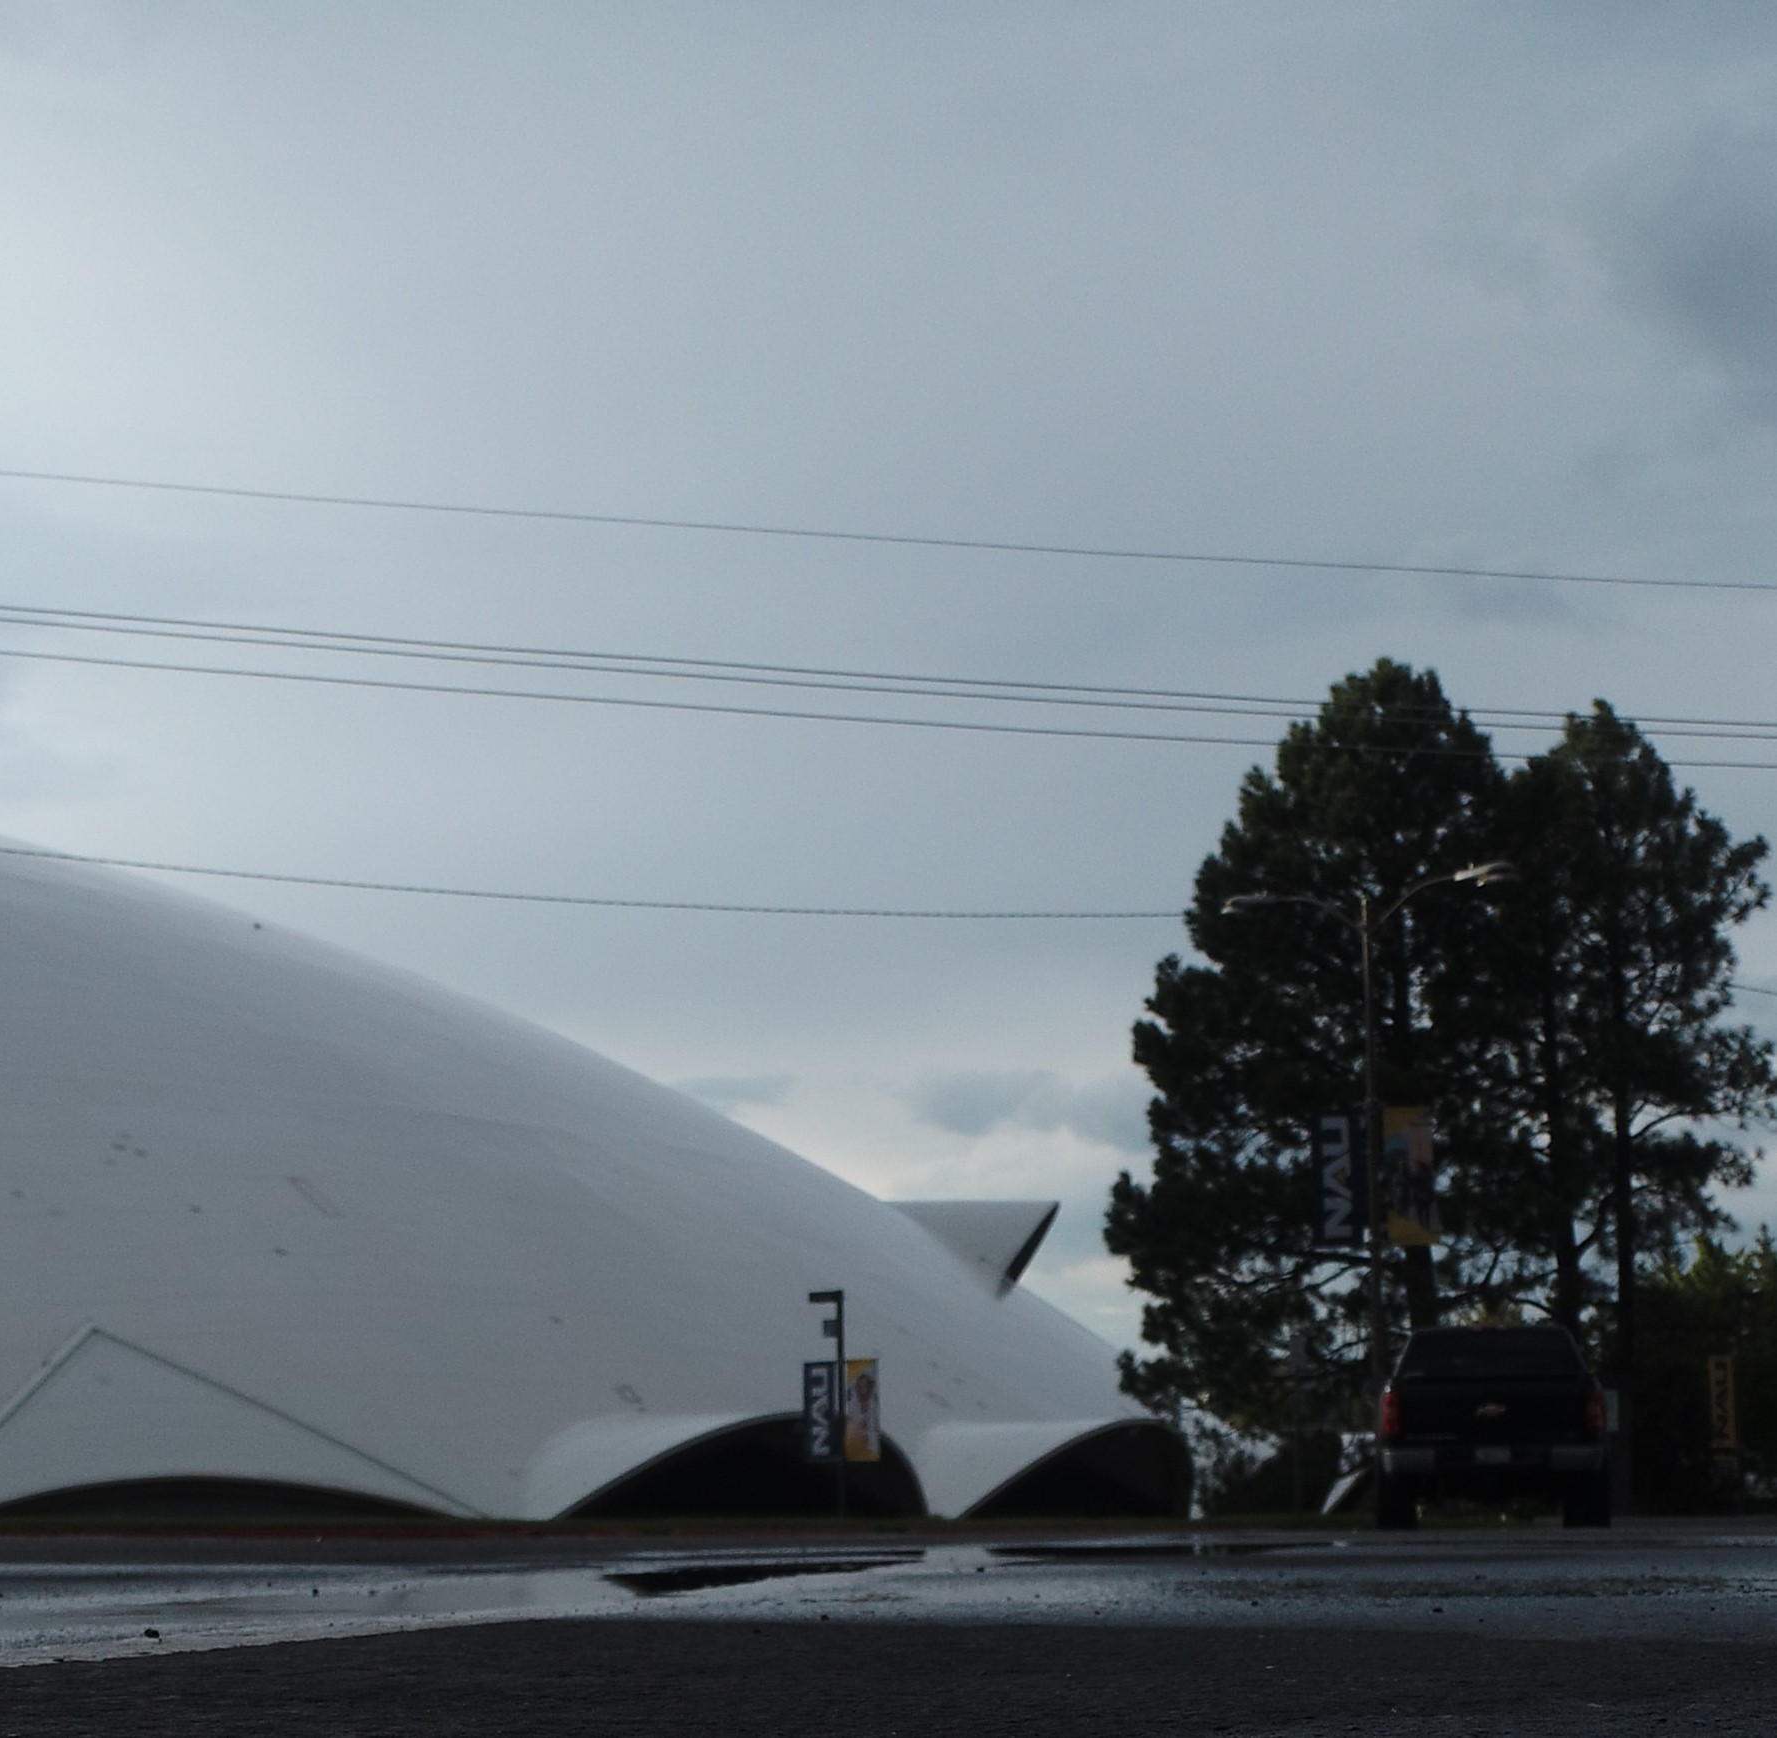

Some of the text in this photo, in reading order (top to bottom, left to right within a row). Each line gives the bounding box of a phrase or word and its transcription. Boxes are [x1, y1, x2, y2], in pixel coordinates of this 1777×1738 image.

[1320, 1116, 1353, 1240] NAU
[811, 1367, 830, 1455] NAU
[1714, 1361, 1729, 1437] NAU
